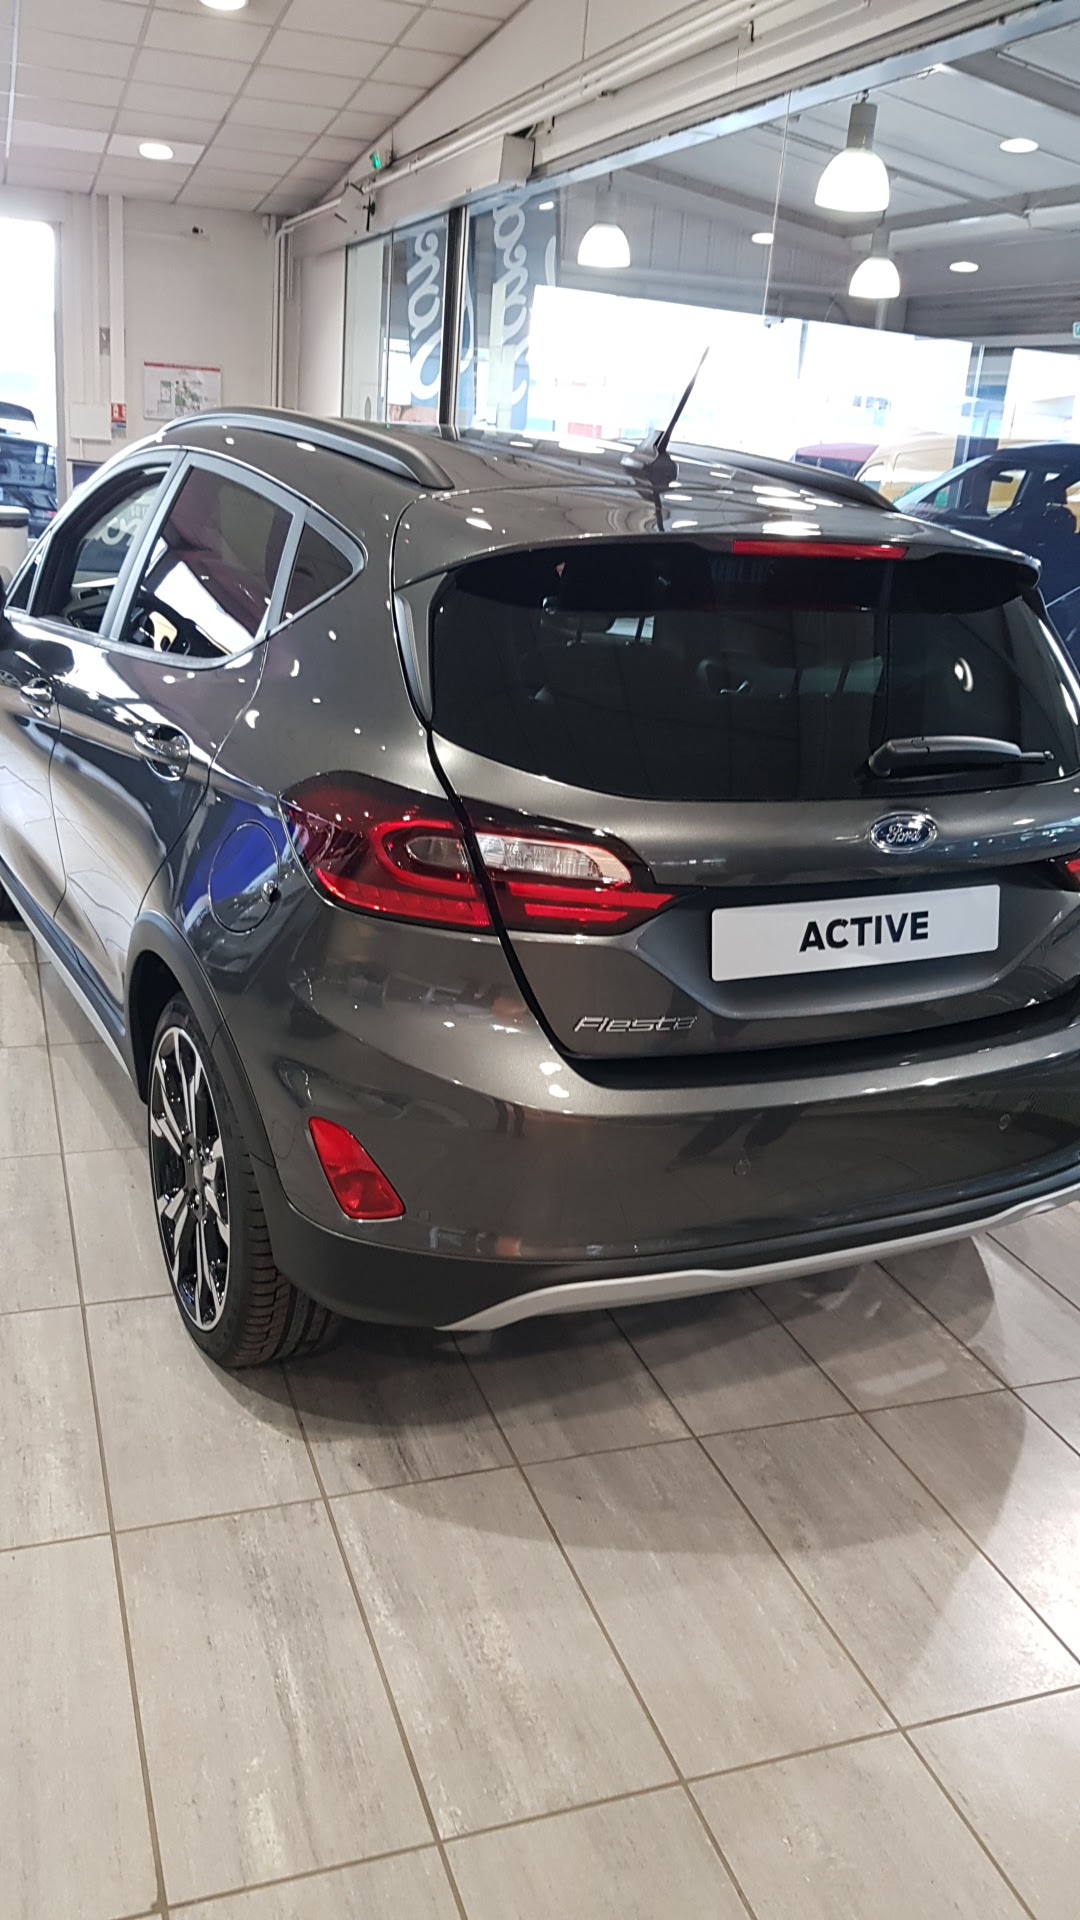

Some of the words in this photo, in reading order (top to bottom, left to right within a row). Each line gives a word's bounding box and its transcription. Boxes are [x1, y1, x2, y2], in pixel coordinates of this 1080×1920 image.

[885, 823, 921, 844] Ford
[799, 911, 929, 953] ACTIVE
[573, 1015, 698, 1033] Fiesta
